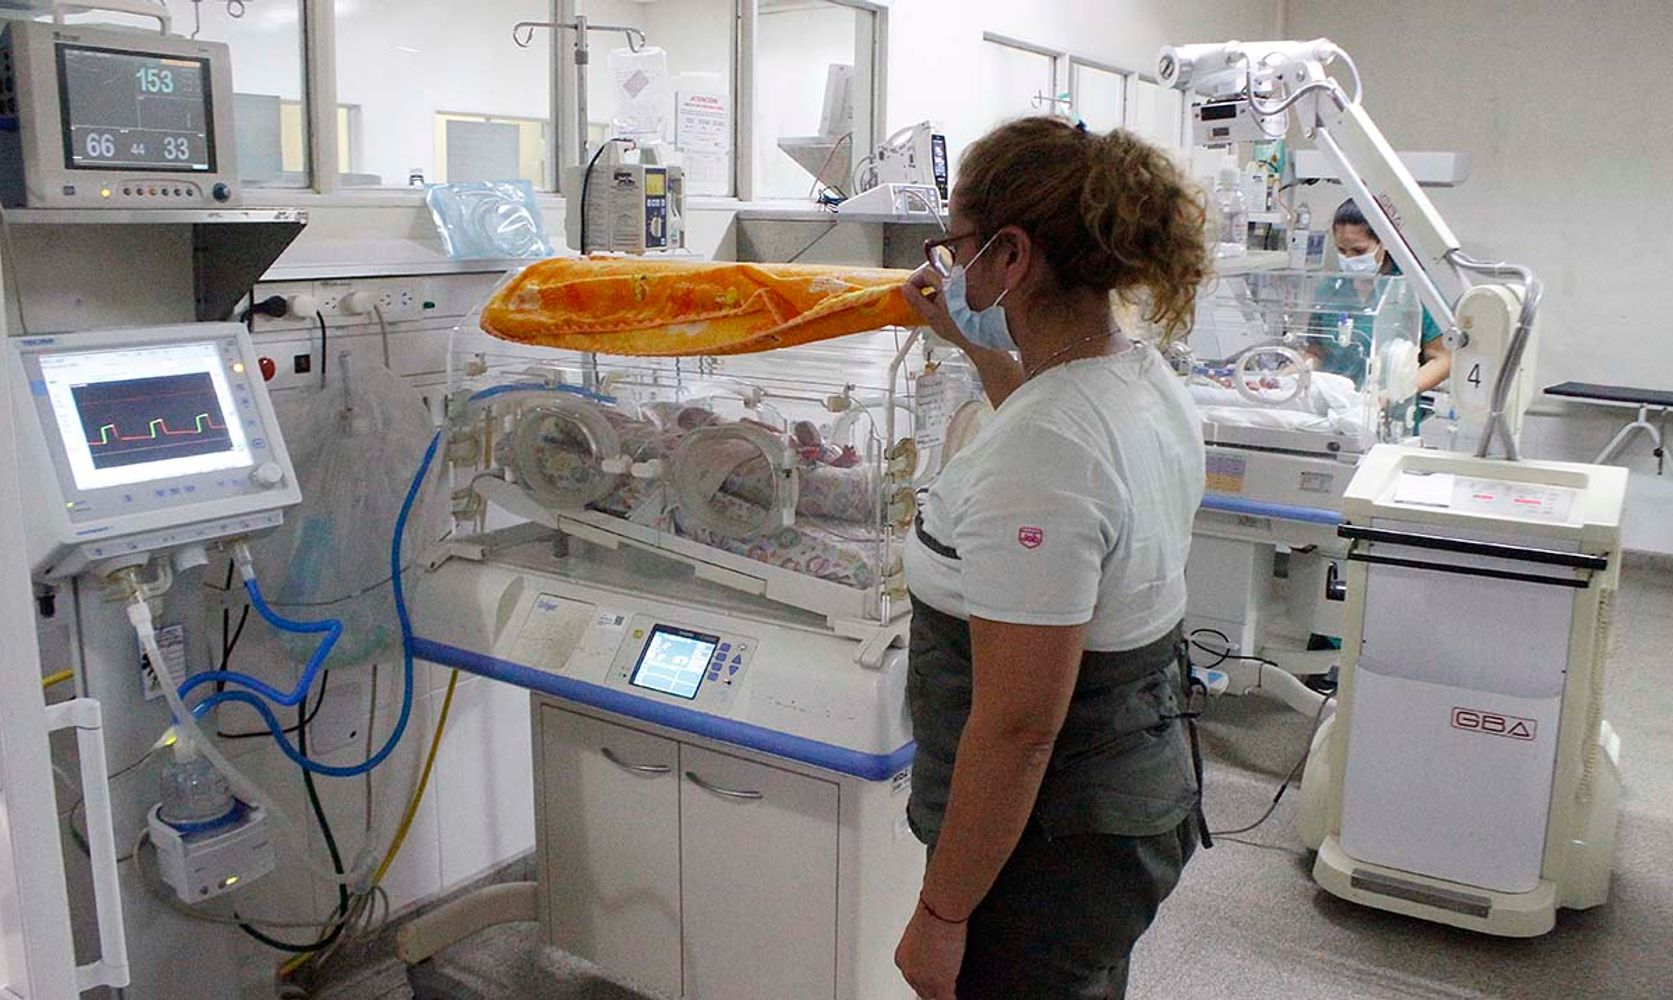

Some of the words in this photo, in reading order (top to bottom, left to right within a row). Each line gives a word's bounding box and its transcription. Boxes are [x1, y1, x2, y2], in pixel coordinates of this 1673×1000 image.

[136, 68, 173, 92] 153
[86, 133, 114, 157] 66
[131, 143, 145, 155] 44
[164, 137, 189, 159] 33
[1467, 363, 1481, 388] 4
[1456, 711, 1531, 737] GBA
